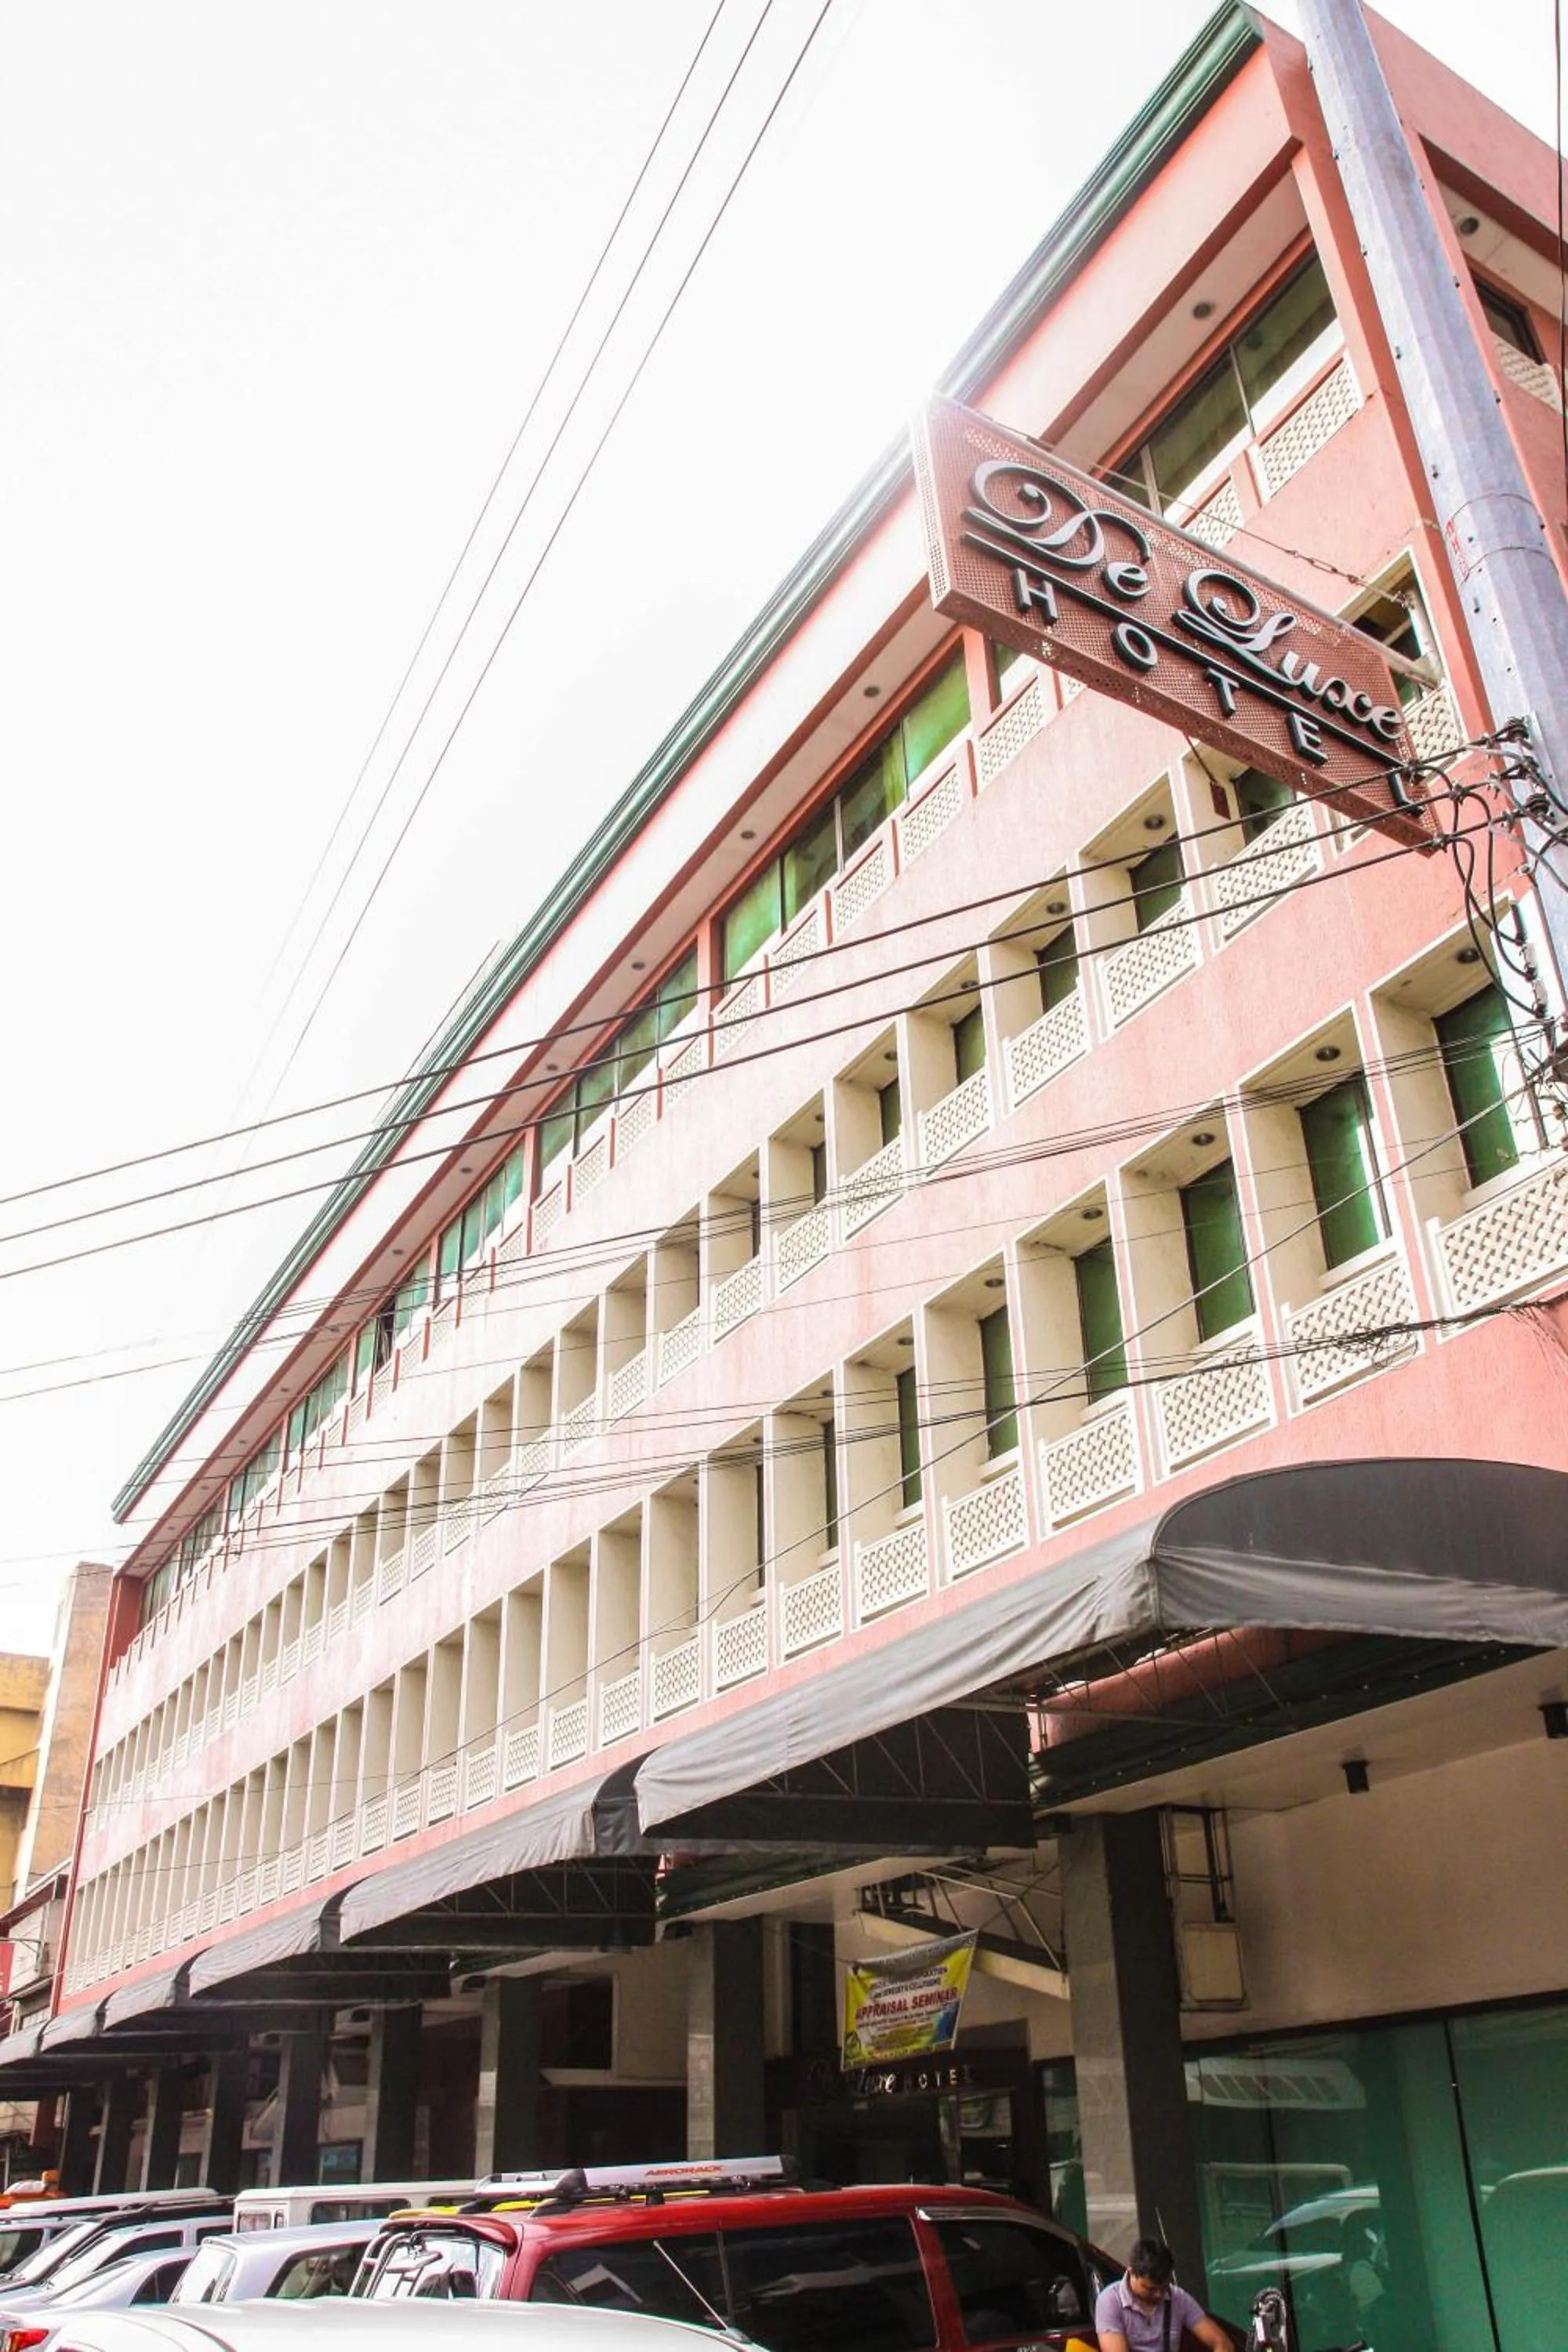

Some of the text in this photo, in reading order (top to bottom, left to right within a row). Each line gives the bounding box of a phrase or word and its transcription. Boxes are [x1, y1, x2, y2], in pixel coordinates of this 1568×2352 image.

[963, 459, 1408, 743] De Luxe
[1012, 568, 1425, 816] HOTEL
[855, 1997, 908, 2021] APPRAISAL
[912, 1987, 957, 2009] SEMINAR
